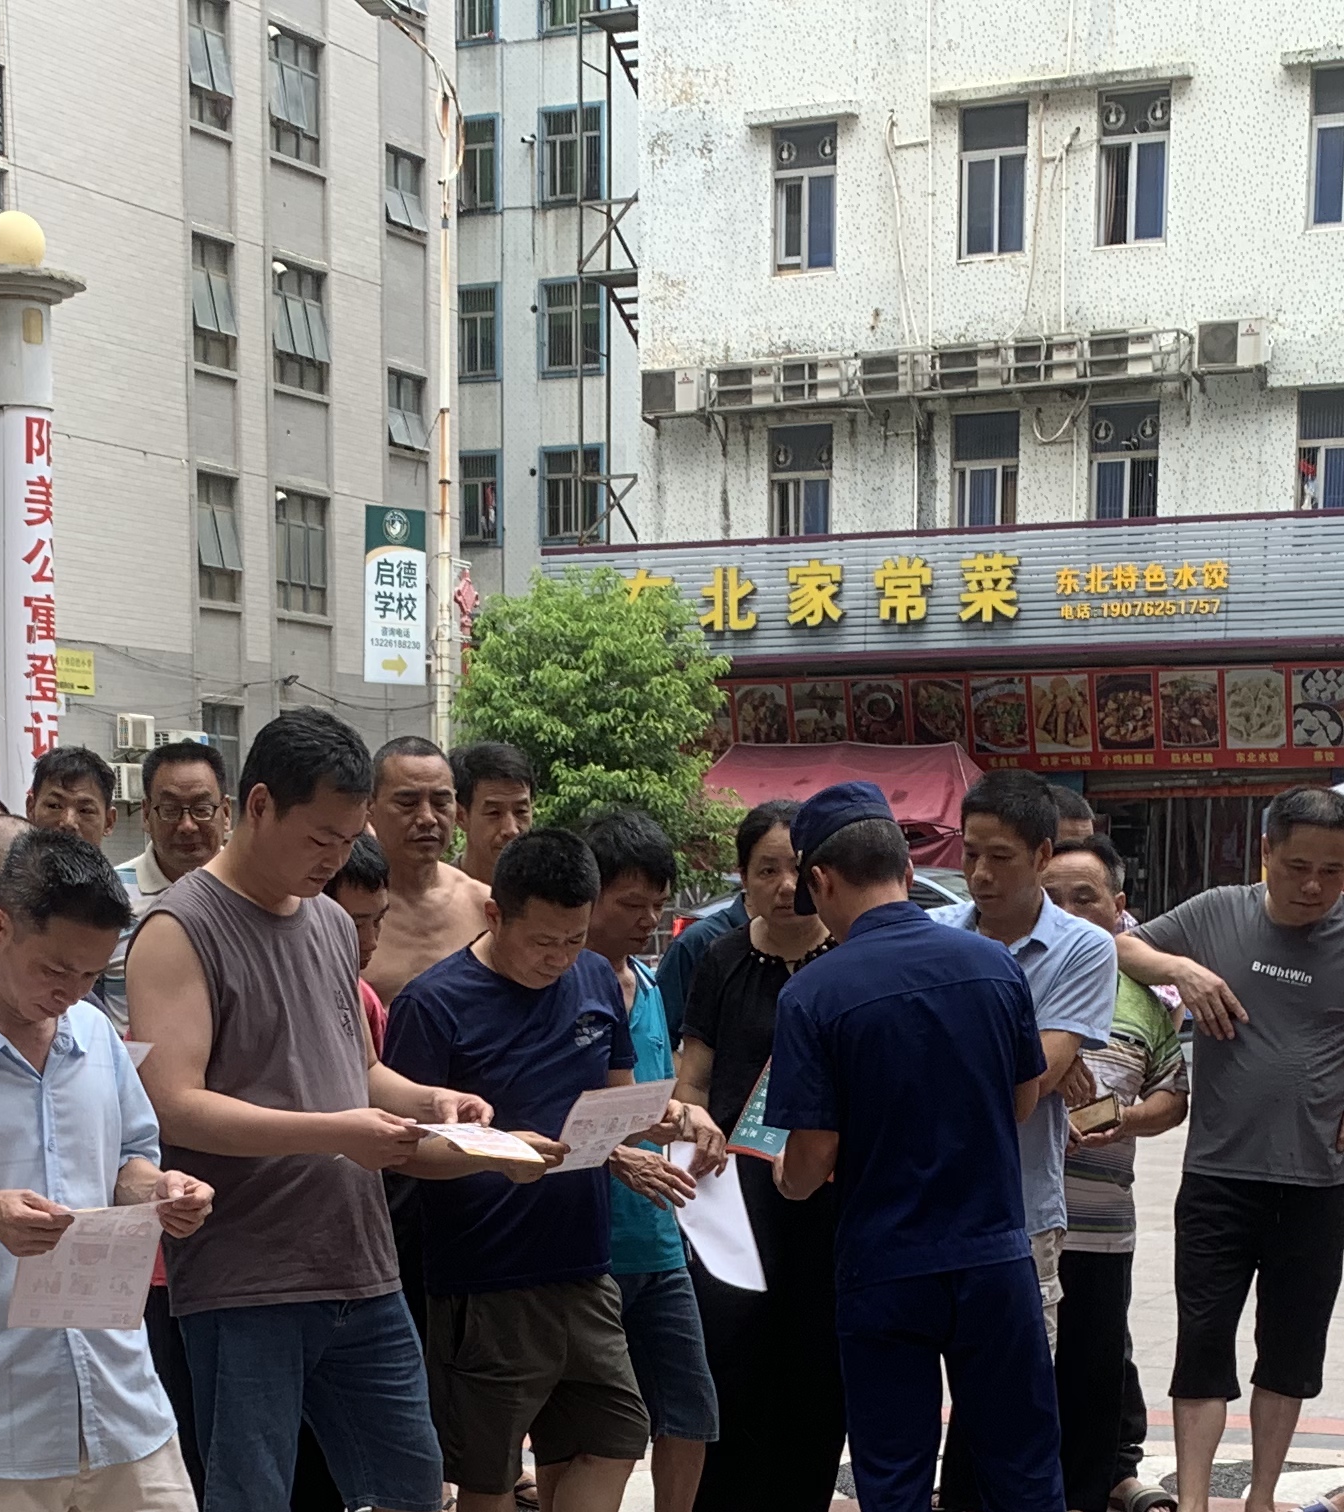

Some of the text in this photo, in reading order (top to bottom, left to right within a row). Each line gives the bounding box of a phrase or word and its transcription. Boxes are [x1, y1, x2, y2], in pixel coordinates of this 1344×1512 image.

[374, 557, 418, 589] 启德
[1056, 560, 1229, 596] 东北特色水饺
[374, 590, 418, 622] 学校
[1236, 751, 1279, 764] 东北水饺
